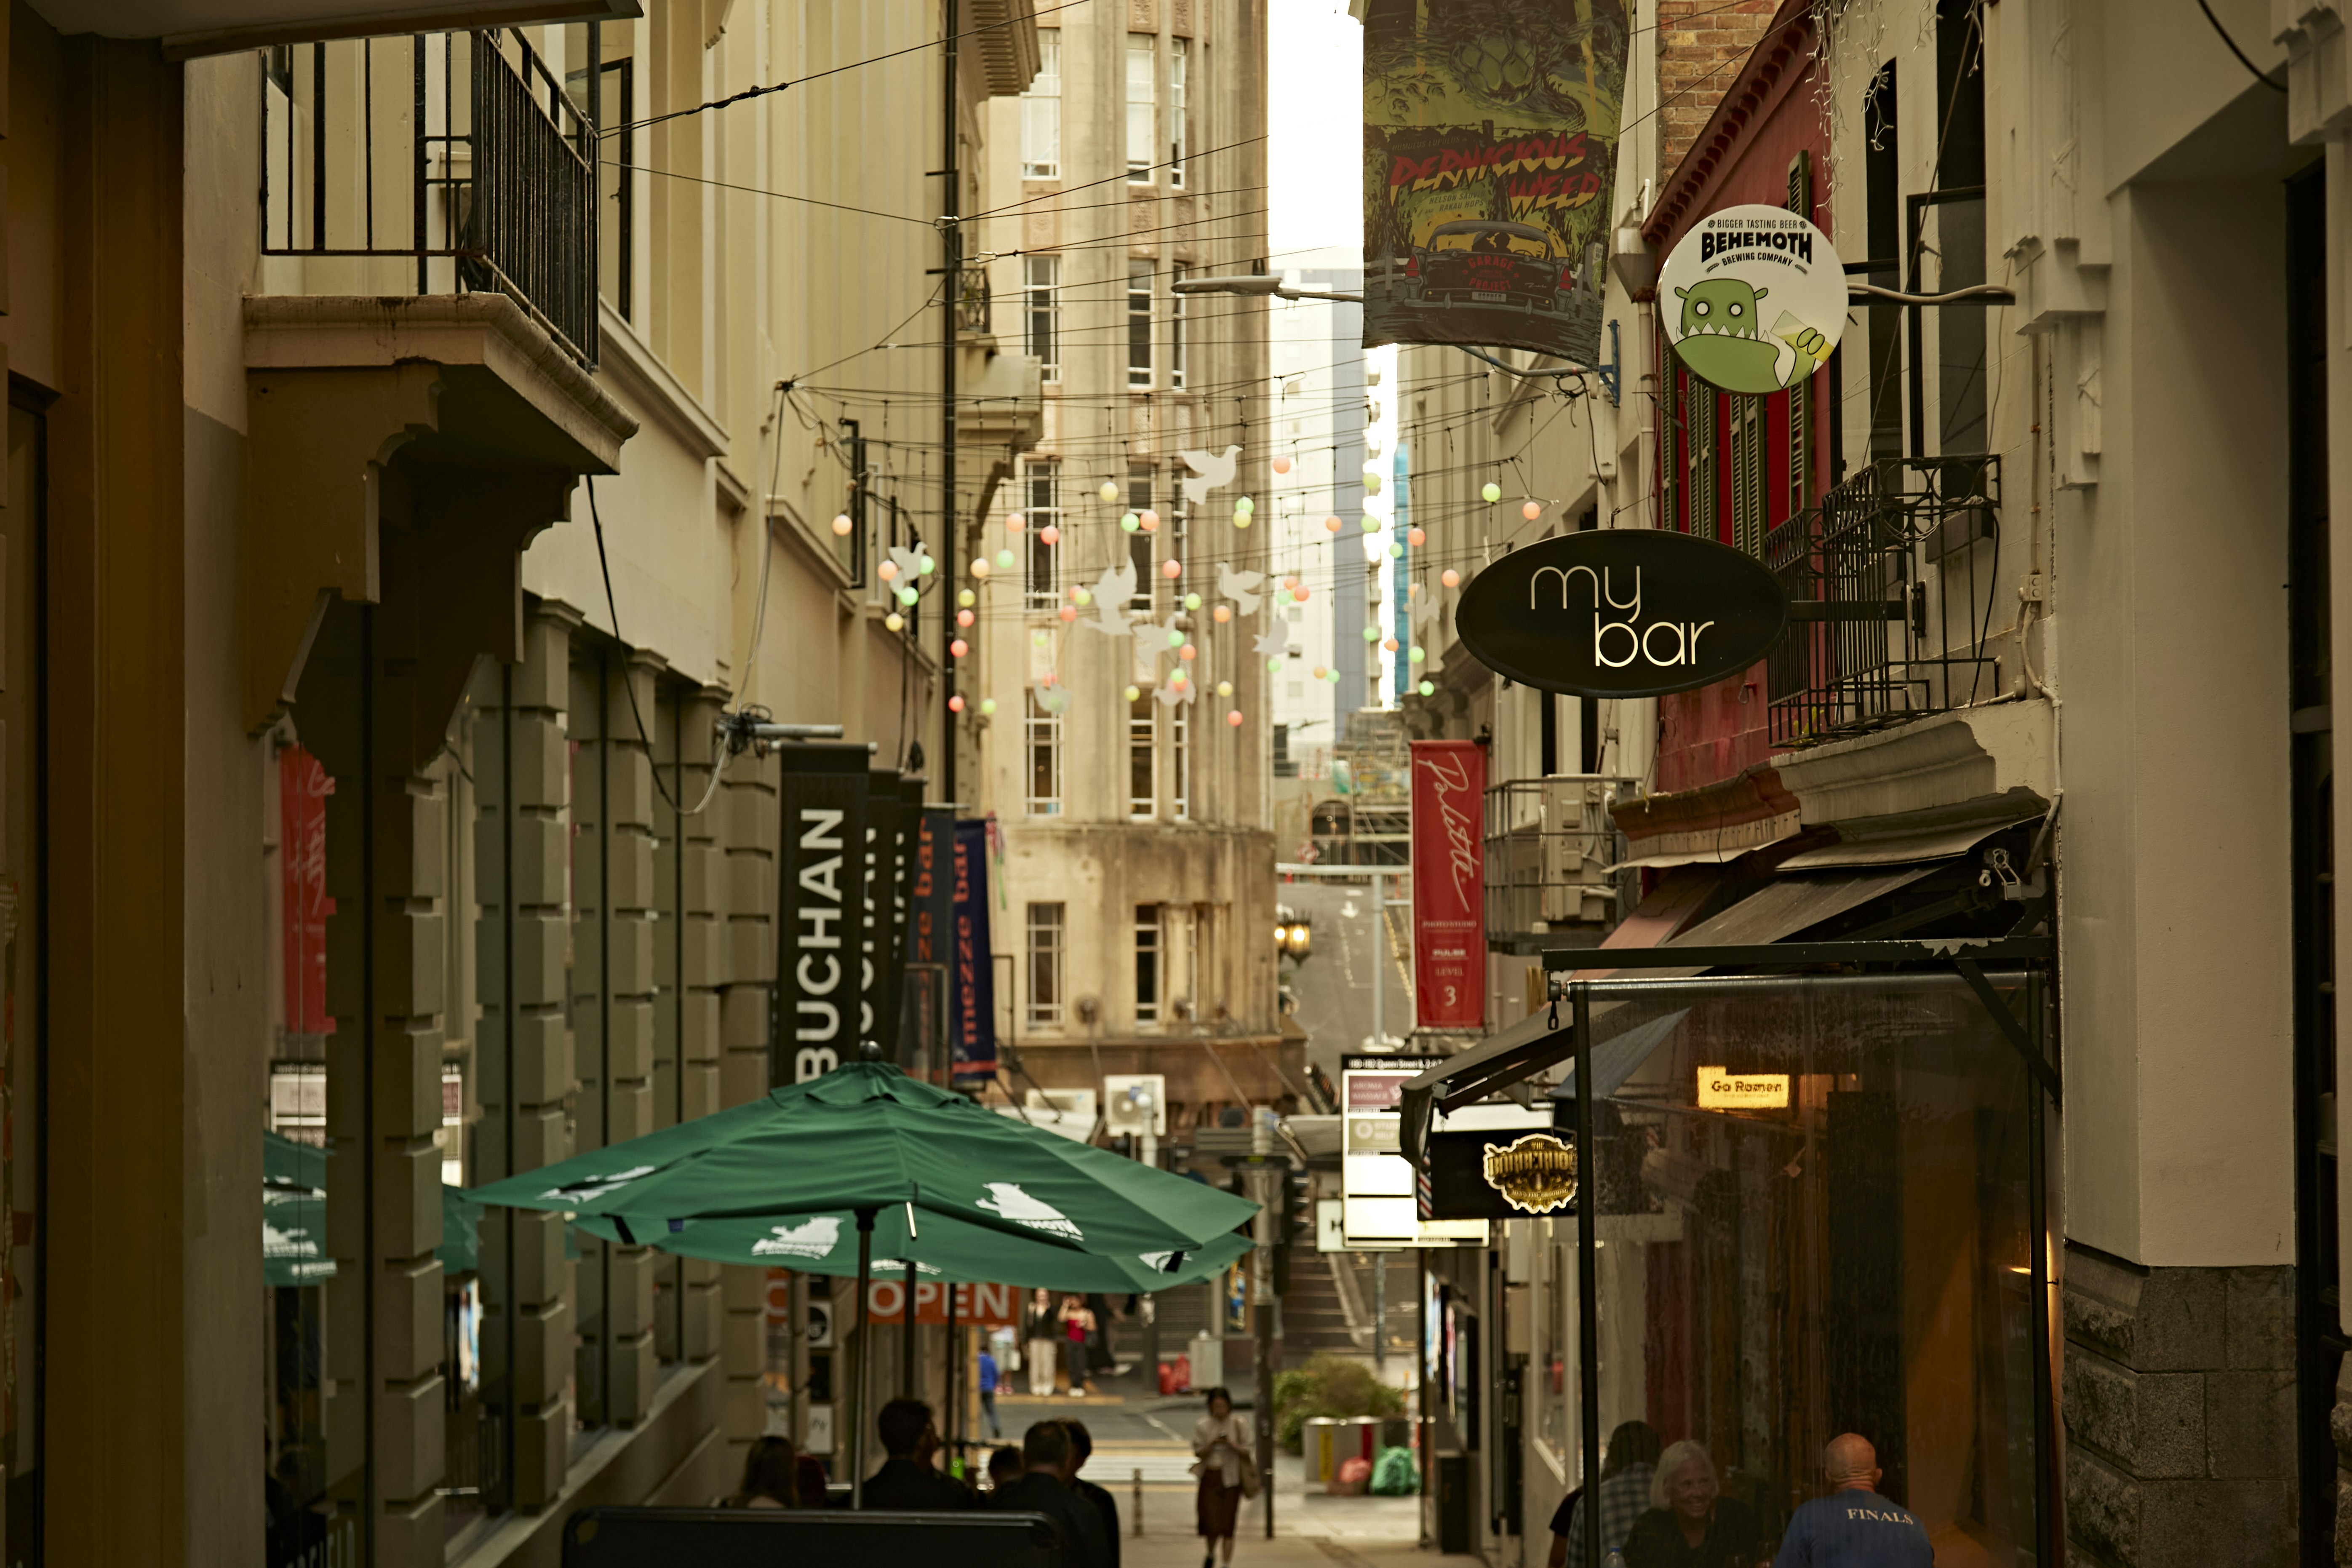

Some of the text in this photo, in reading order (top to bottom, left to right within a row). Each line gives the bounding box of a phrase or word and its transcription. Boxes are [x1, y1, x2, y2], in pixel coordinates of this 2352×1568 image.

[1392, 142, 1426, 152] HUMULUS
[1428, 136, 1460, 147] LUPULUS
[1390, 130, 1588, 207] PERNICIOUS
[1430, 191, 1486, 205] NELSON SAUVIN
[1439, 202, 1464, 212] RAKAU
[1465, 200, 1484, 210] HOPS
[1508, 172, 1602, 221] WEED
[1717, 219, 1797, 229] BIGGER TASTING BEER
[1701, 232, 1812, 265] BEHEMOTH
[1468, 255, 1515, 270] GARAGE
[1722, 252, 1793, 267] BREWING COMPANY
[1468, 276, 1511, 291] PROJECT
[1531, 566, 1641, 623] my
[1595, 612, 1714, 667] bar
[796, 809, 844, 1085] BUCHAN
[953, 836, 977, 1045] mezze bar
[1435, 967, 1463, 976] LEVEL
[1444, 985, 1457, 1007] 3
[867, 1280, 1009, 1319] OPEN
[1846, 1508, 1914, 1526] FINALS
